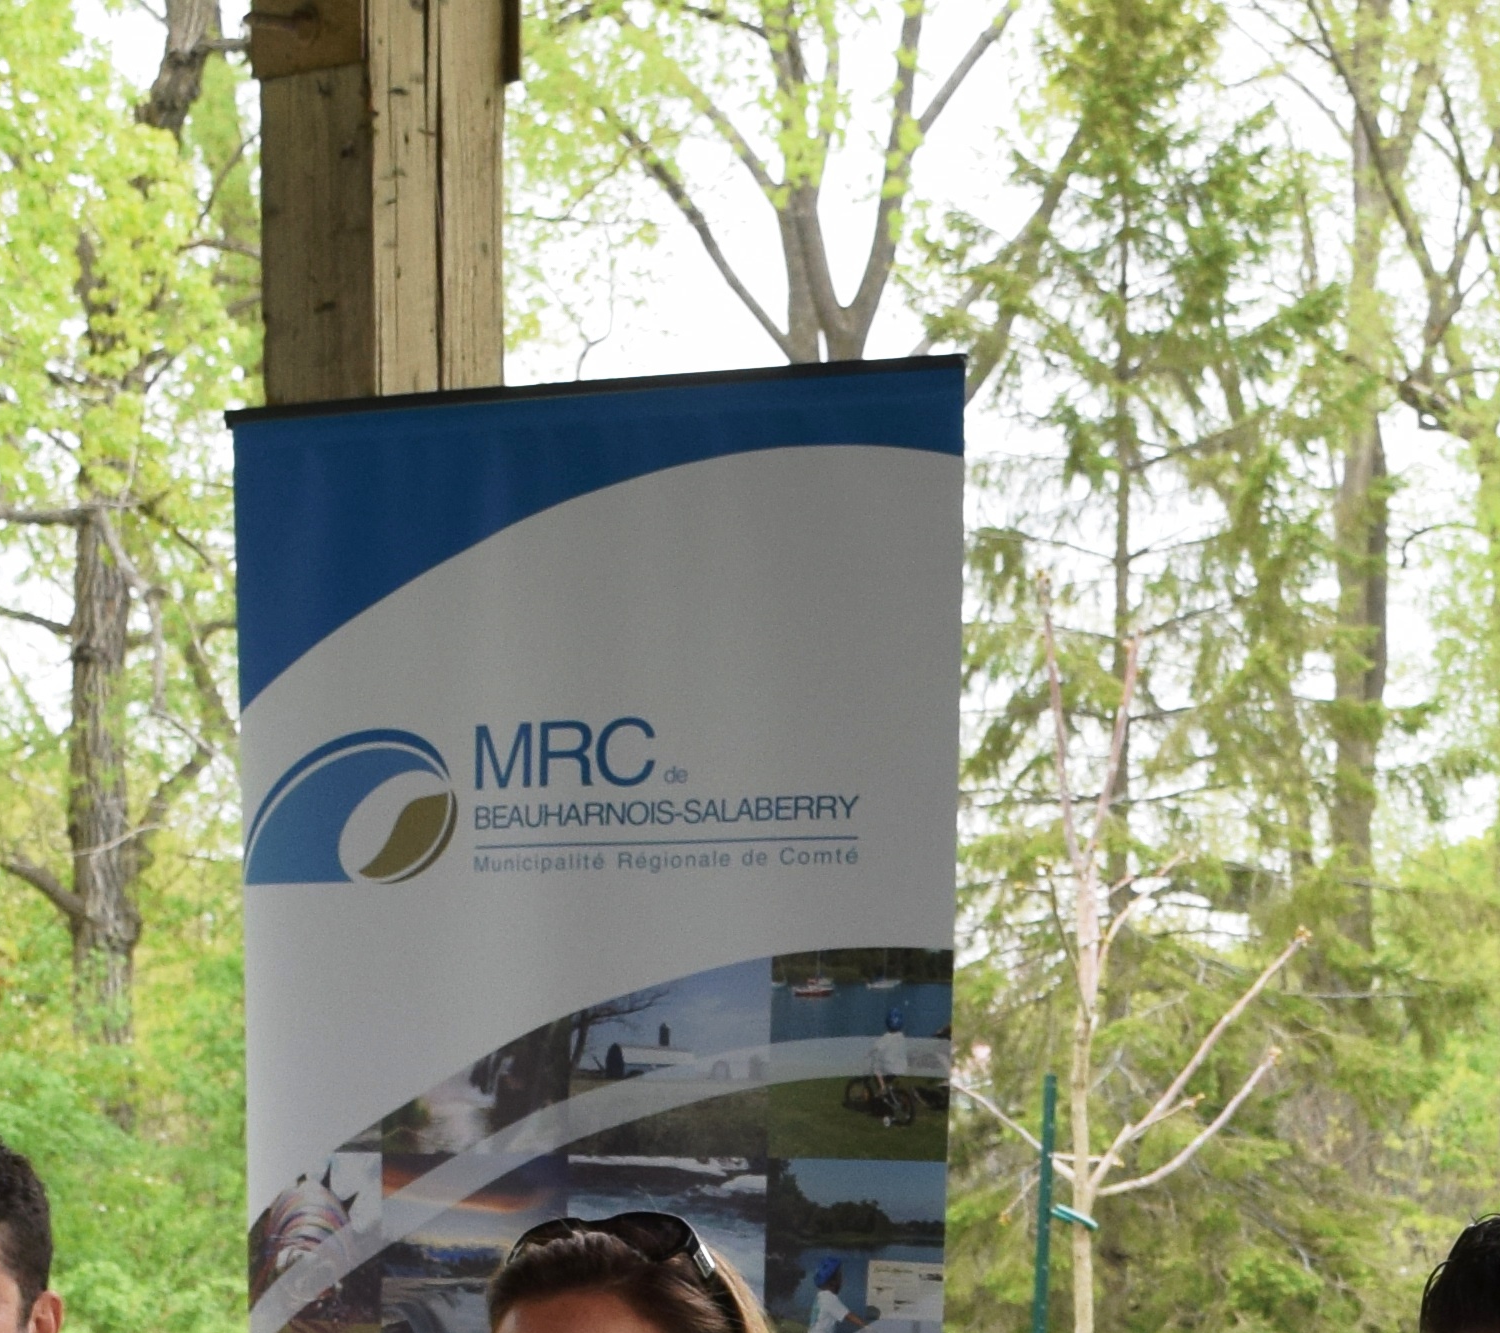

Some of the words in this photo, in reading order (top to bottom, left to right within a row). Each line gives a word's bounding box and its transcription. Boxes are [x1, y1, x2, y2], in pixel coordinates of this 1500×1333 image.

[475, 717, 656, 790] MRC
[664, 765, 687, 785] de
[474, 795, 860, 831] BEAUHARNOIS-SALABERRY
[474, 849, 605, 874] Municipalité
[617, 847, 730, 874] Régionale
[742, 847, 768, 867] de
[779, 846, 859, 867] Comté
